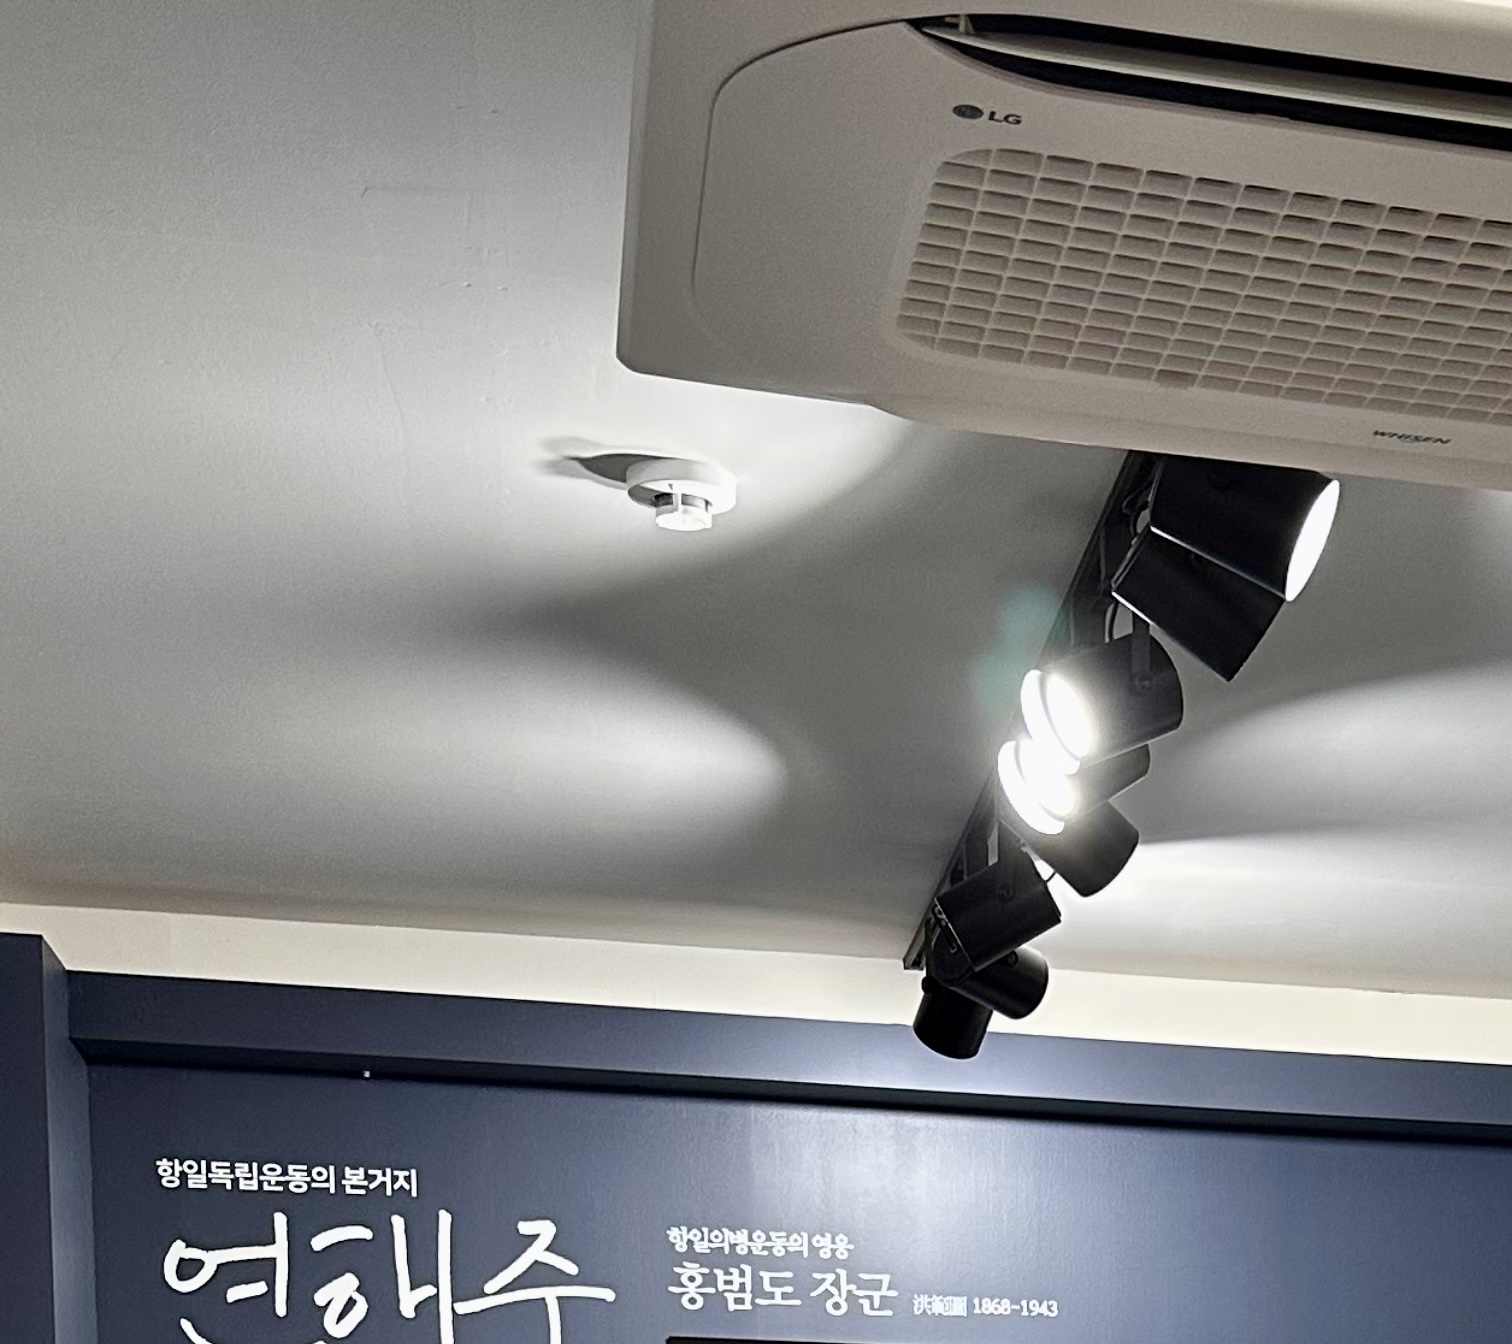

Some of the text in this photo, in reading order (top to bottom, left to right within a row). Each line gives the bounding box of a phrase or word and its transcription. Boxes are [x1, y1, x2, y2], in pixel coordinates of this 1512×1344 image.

[988, 110, 1022, 125] LG
[156, 1157, 418, 1198] 항일독립운동의 본거지
[667, 1226, 855, 1260] 항일의병운동의 영웅
[668, 1261, 898, 1317] 홍범도 장군
[973, 1297, 1059, 1318] 1868-1943
